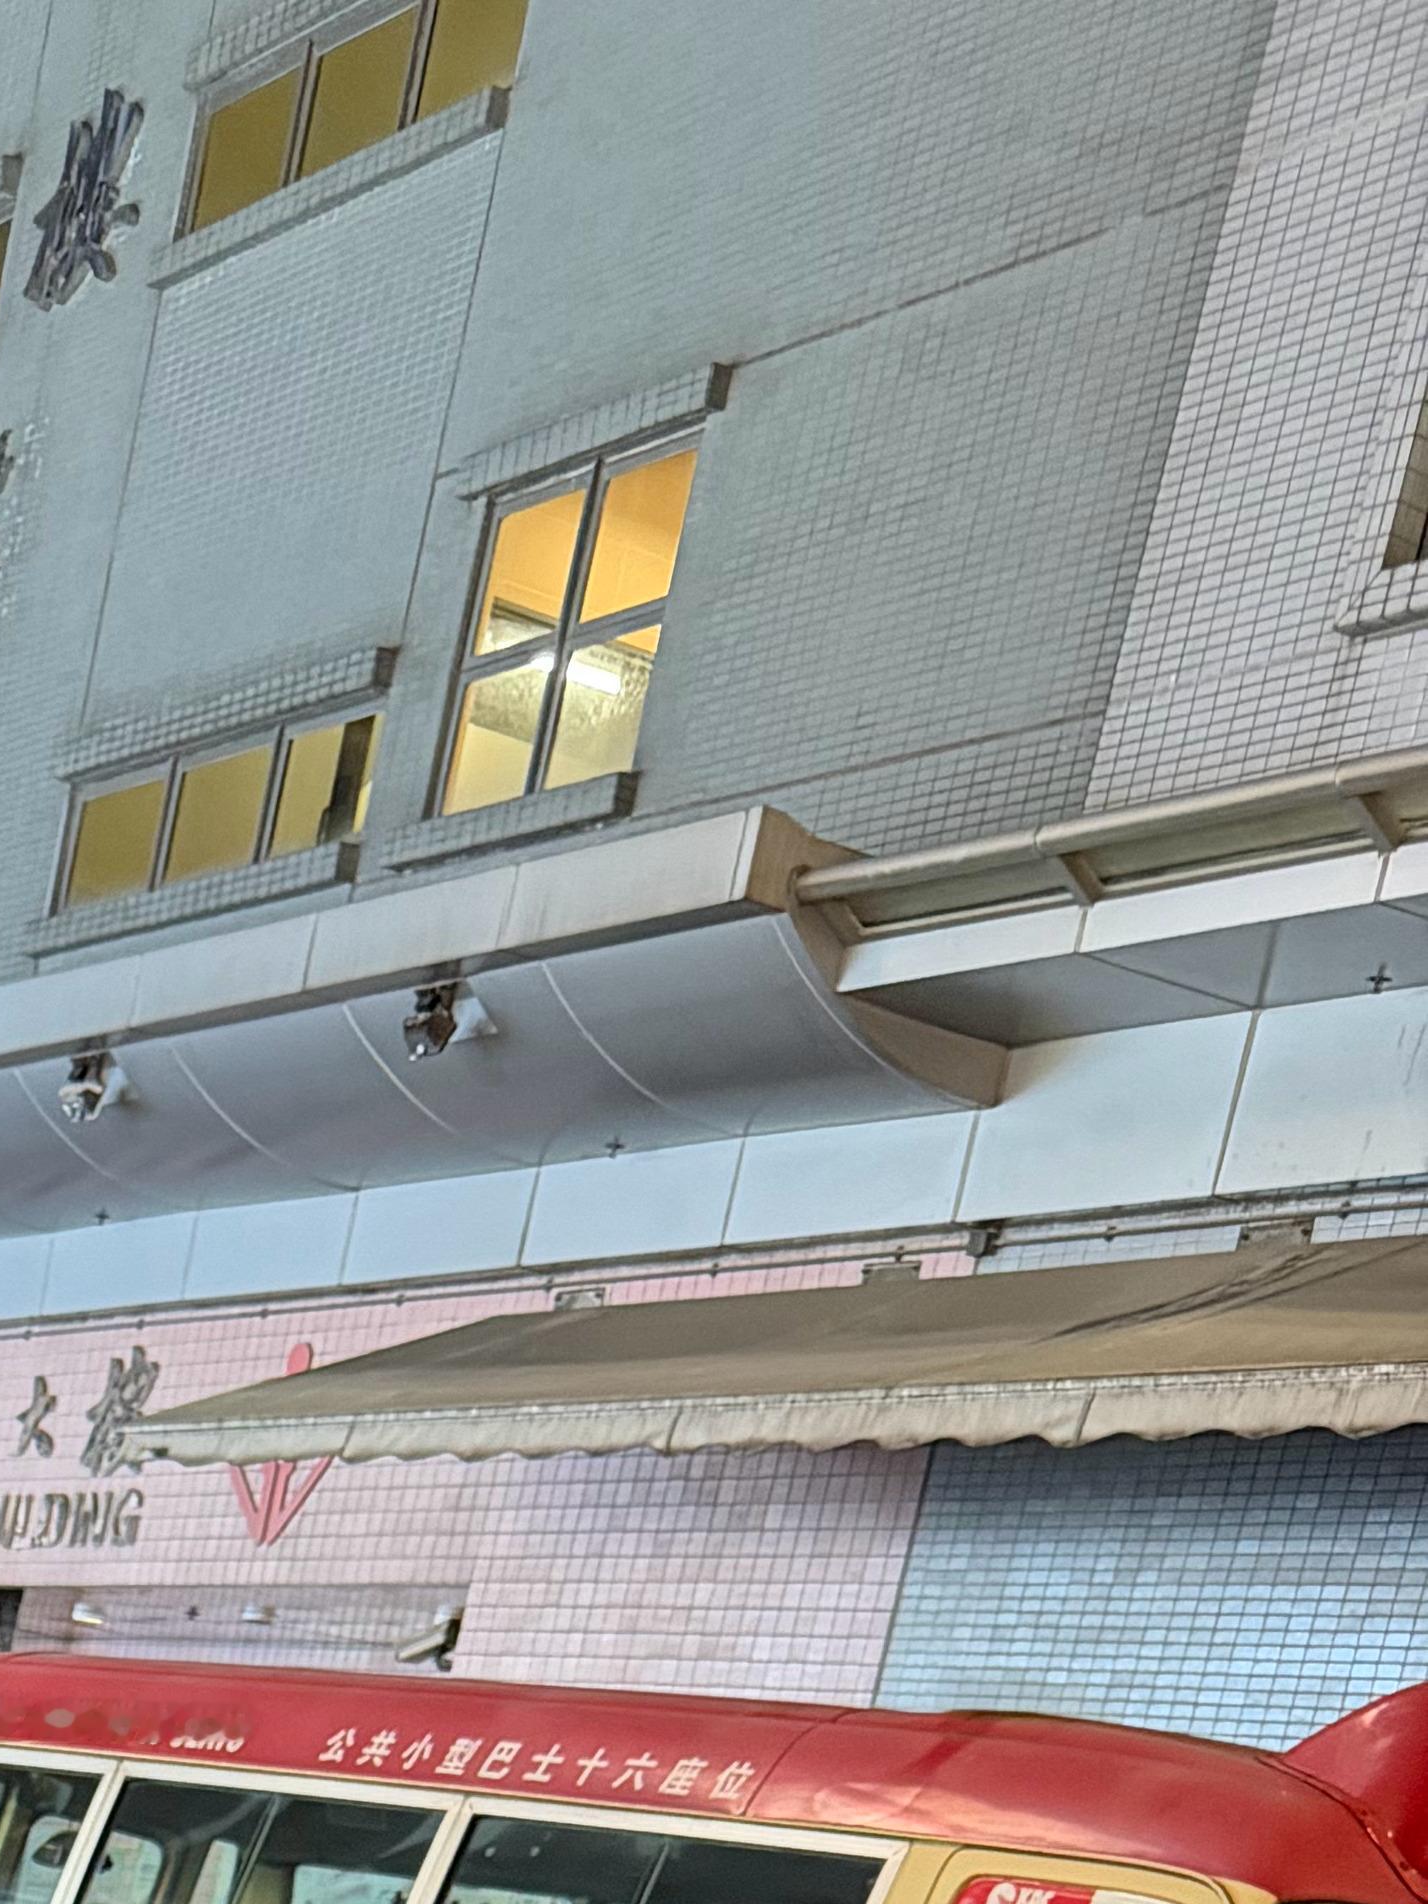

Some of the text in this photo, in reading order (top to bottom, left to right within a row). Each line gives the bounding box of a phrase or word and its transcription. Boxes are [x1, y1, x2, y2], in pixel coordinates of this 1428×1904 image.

[317, 1727, 757, 1803] 公共小型巴士十六座位
